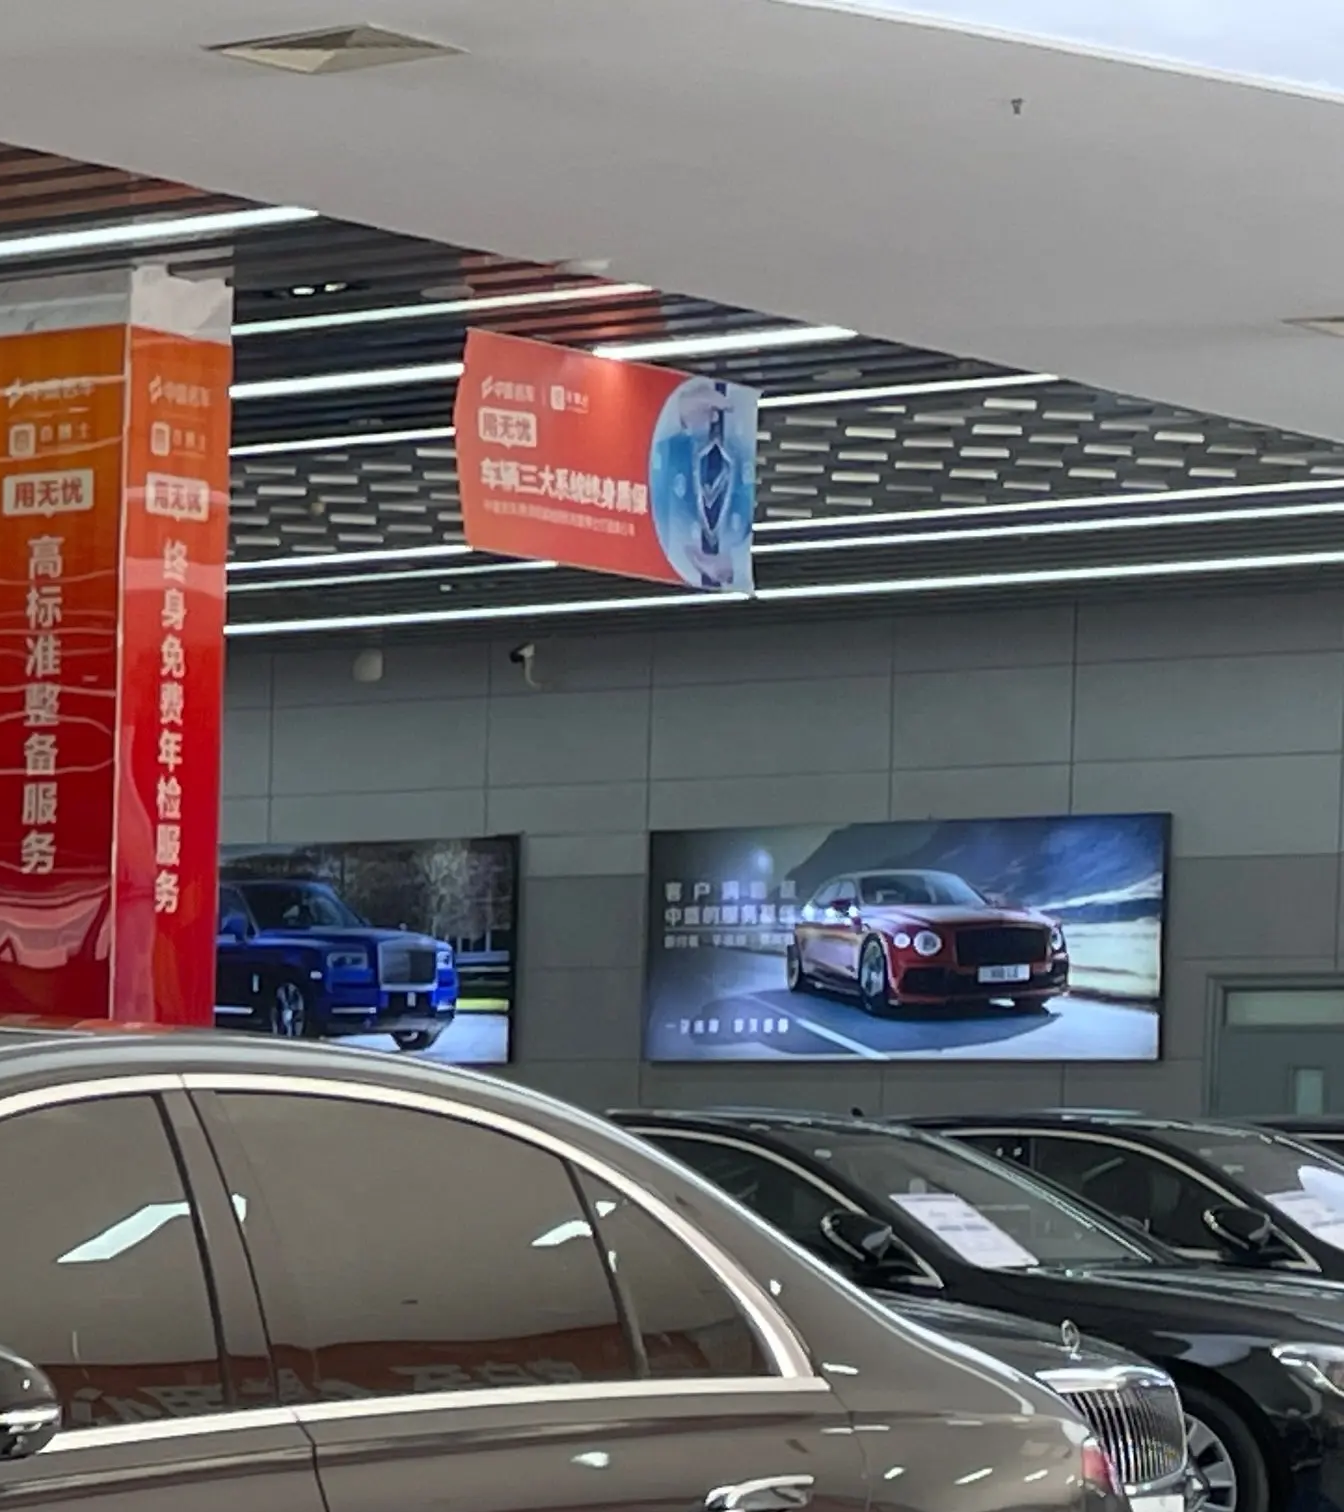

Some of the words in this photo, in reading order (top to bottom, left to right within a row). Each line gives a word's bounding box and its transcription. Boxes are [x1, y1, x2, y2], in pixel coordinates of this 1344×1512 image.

[15, 478, 83, 510] 用无忧
[483, 413, 531, 441] 用无忧
[21, 535, 64, 875] 高标准整备服务
[154, 538, 188, 914] 终身免费年检服务
